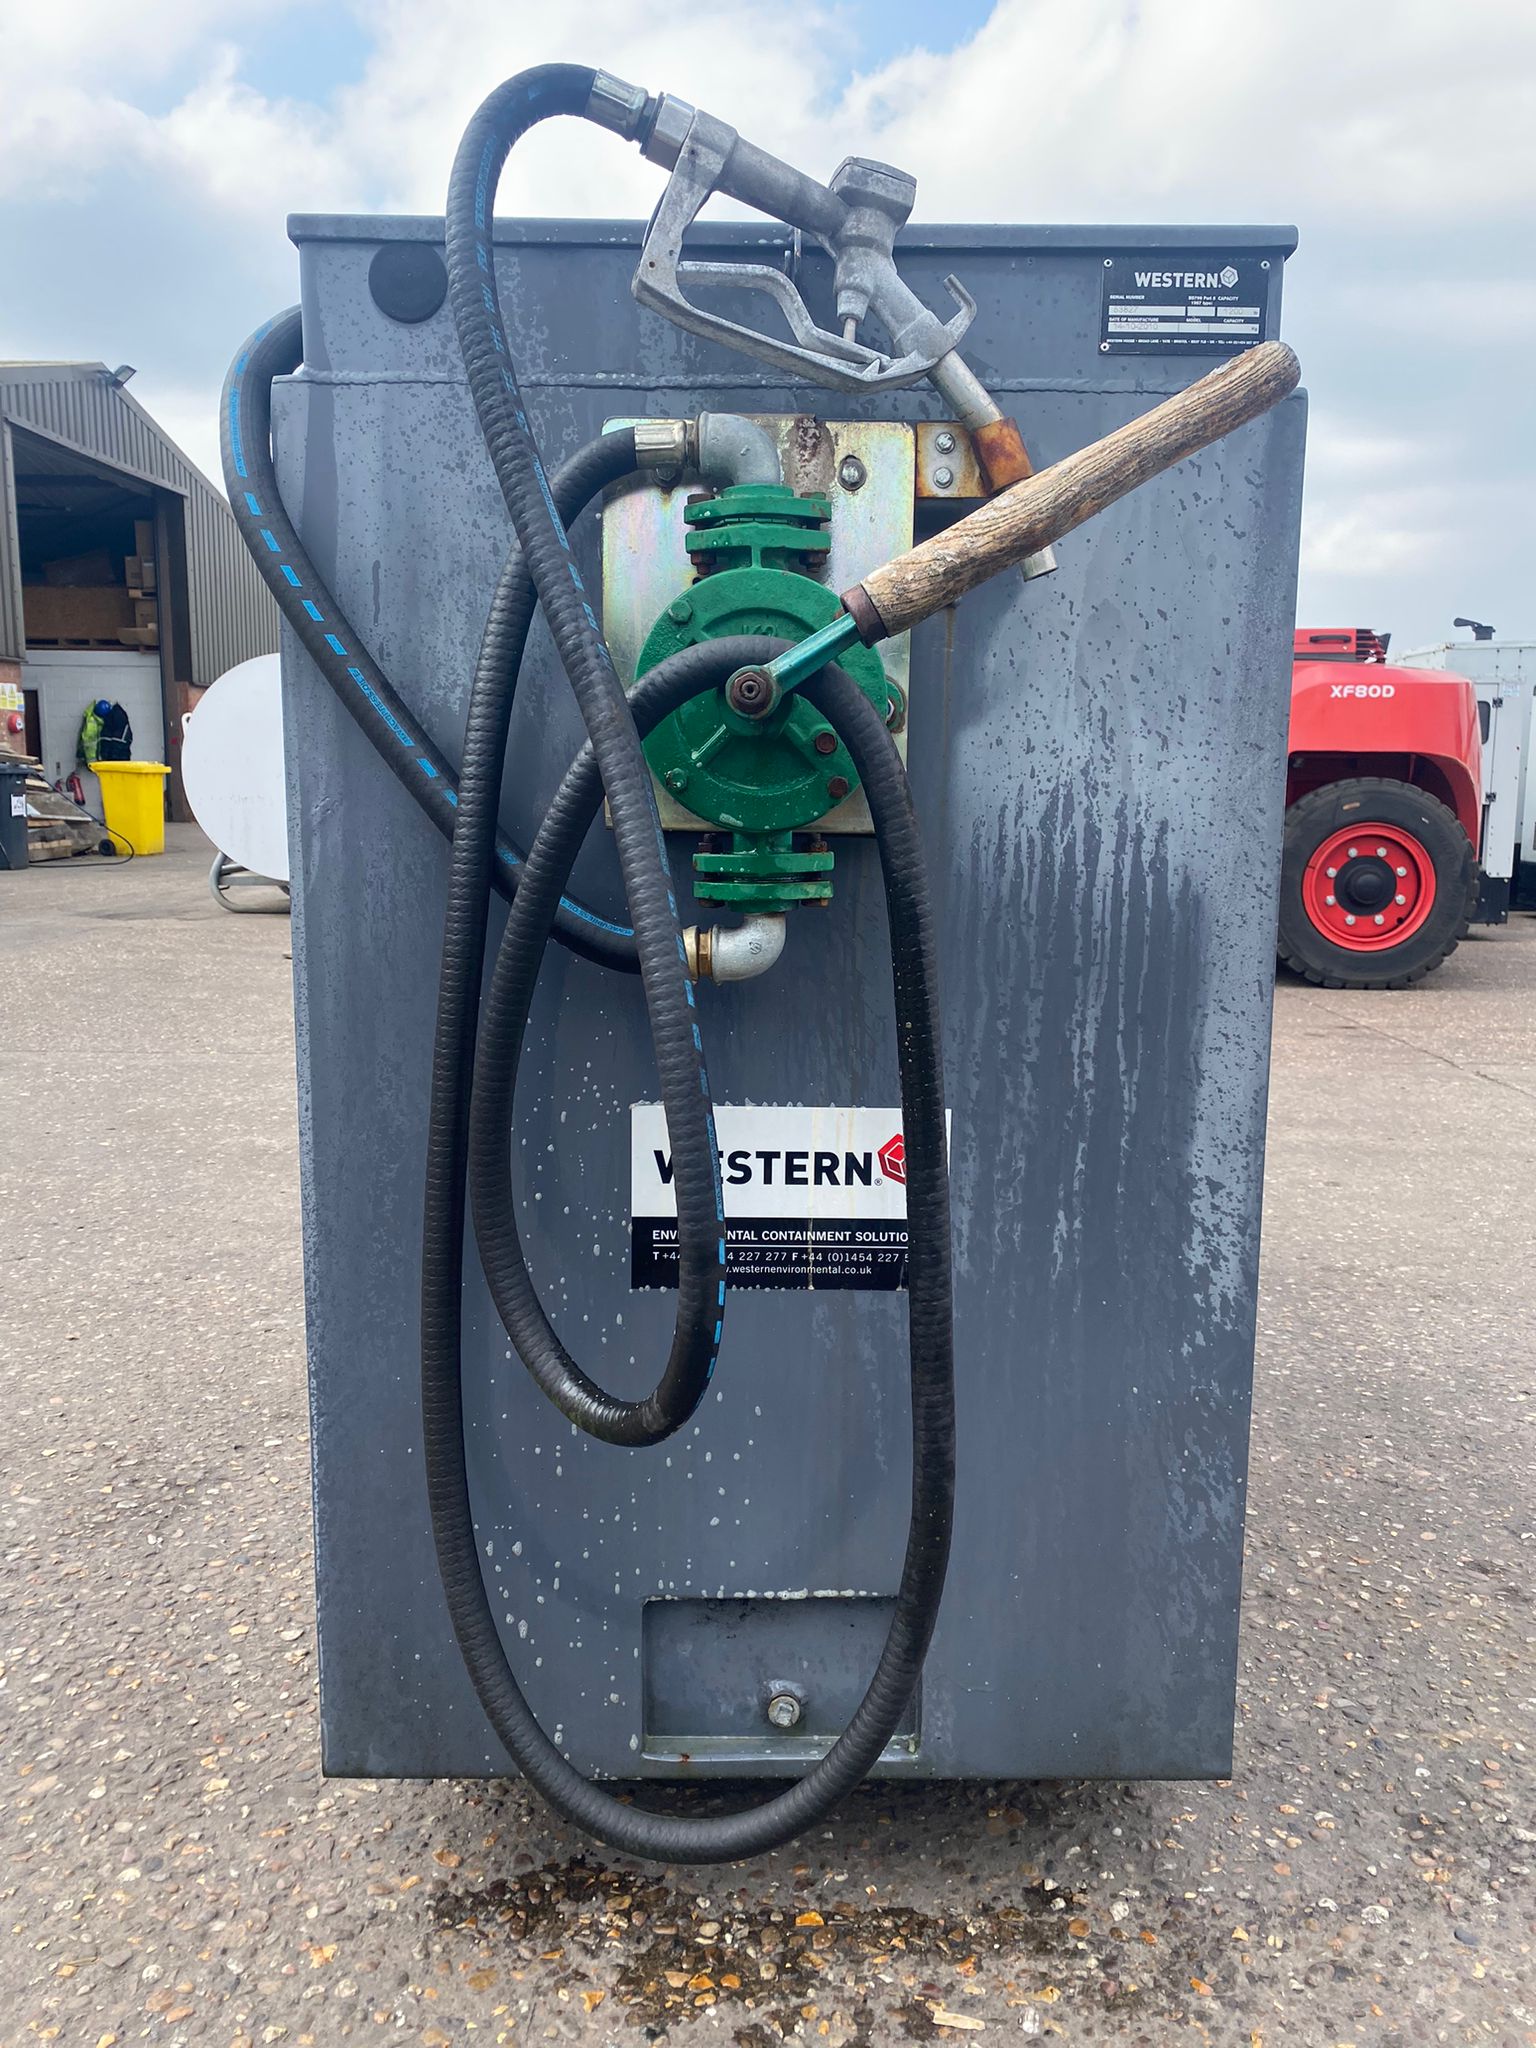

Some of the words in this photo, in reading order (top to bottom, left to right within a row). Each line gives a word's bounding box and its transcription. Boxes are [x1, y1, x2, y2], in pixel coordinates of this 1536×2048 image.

[1134, 272, 1219, 288] WESTERN
[1330, 684, 1395, 698] XF80D
[762, 1231, 851, 1241] CONTAINMENT
[653, 1252, 659, 1260] T
[739, 1252, 760, 1261] 227
[766, 1252, 787, 1261] 277
[792, 1253, 798, 1261] F
[801, 1253, 823, 1261] +44
[827, 1253, 873, 1262] (0)1454
[878, 1254, 899, 1262] 227
